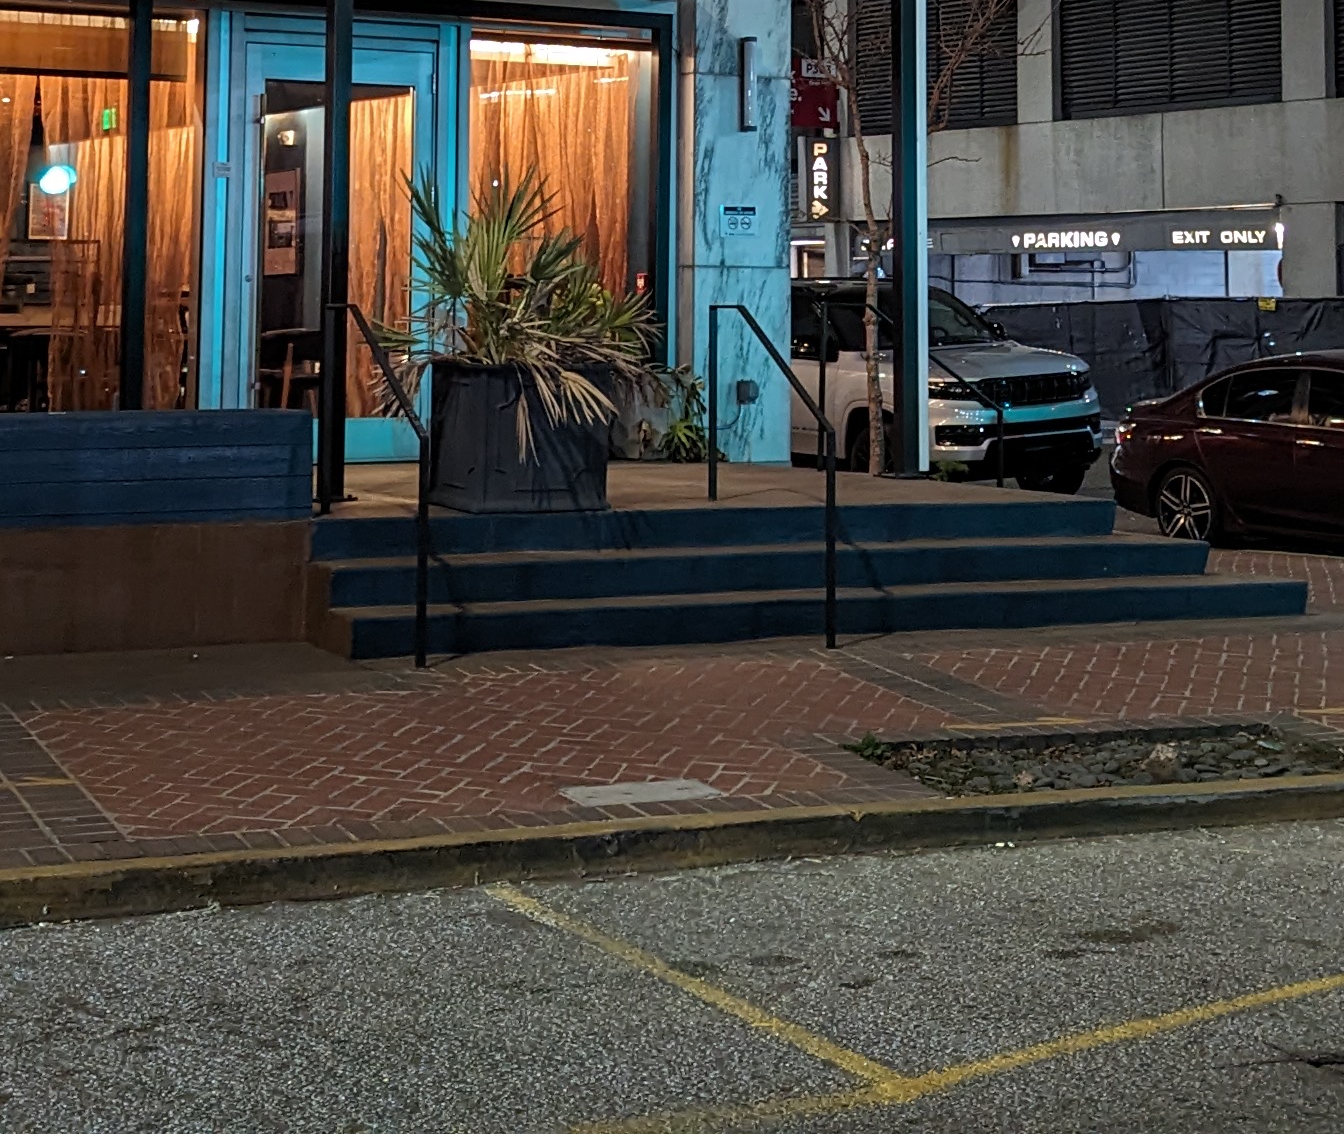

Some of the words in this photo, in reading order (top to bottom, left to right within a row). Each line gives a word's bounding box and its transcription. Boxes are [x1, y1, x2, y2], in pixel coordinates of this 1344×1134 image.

[812, 143, 828, 200] PARK
[1023, 231, 1109, 248] PARKING
[1172, 230, 1210, 244] EXIT
[1220, 230, 1266, 244] ONLY
